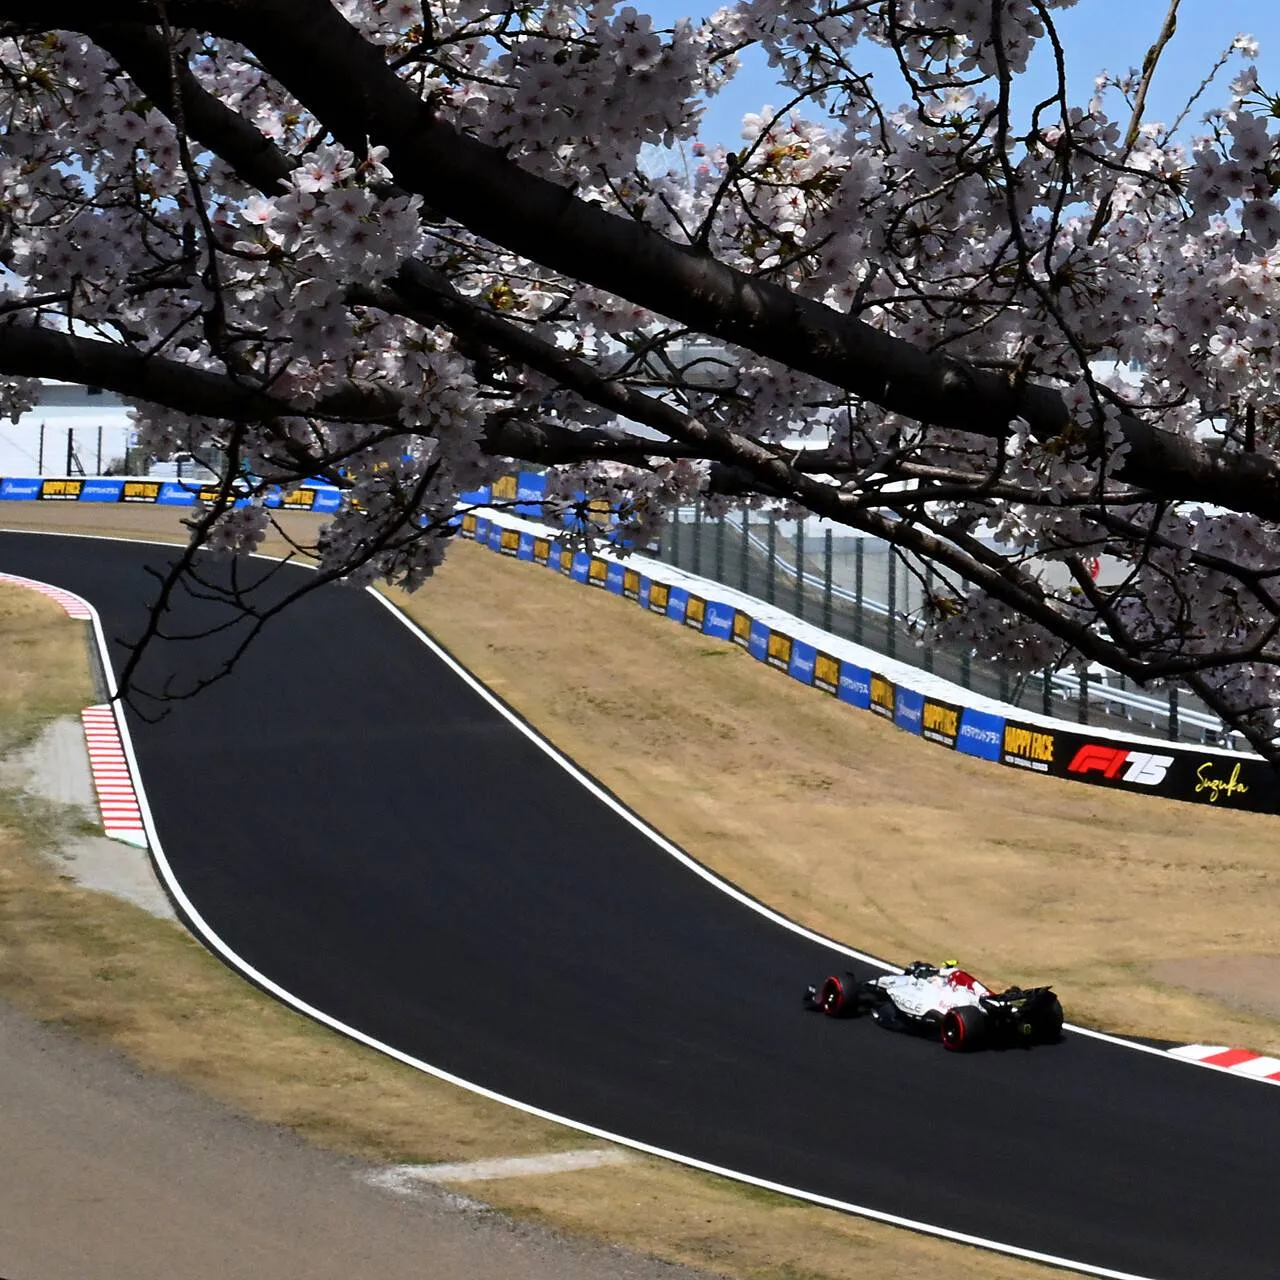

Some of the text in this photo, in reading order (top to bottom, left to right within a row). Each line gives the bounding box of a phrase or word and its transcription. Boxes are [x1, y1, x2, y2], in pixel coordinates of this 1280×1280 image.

[1004, 726, 1054, 762] HAPPY FACE
[1194, 762, 1248, 802] Suzuka
